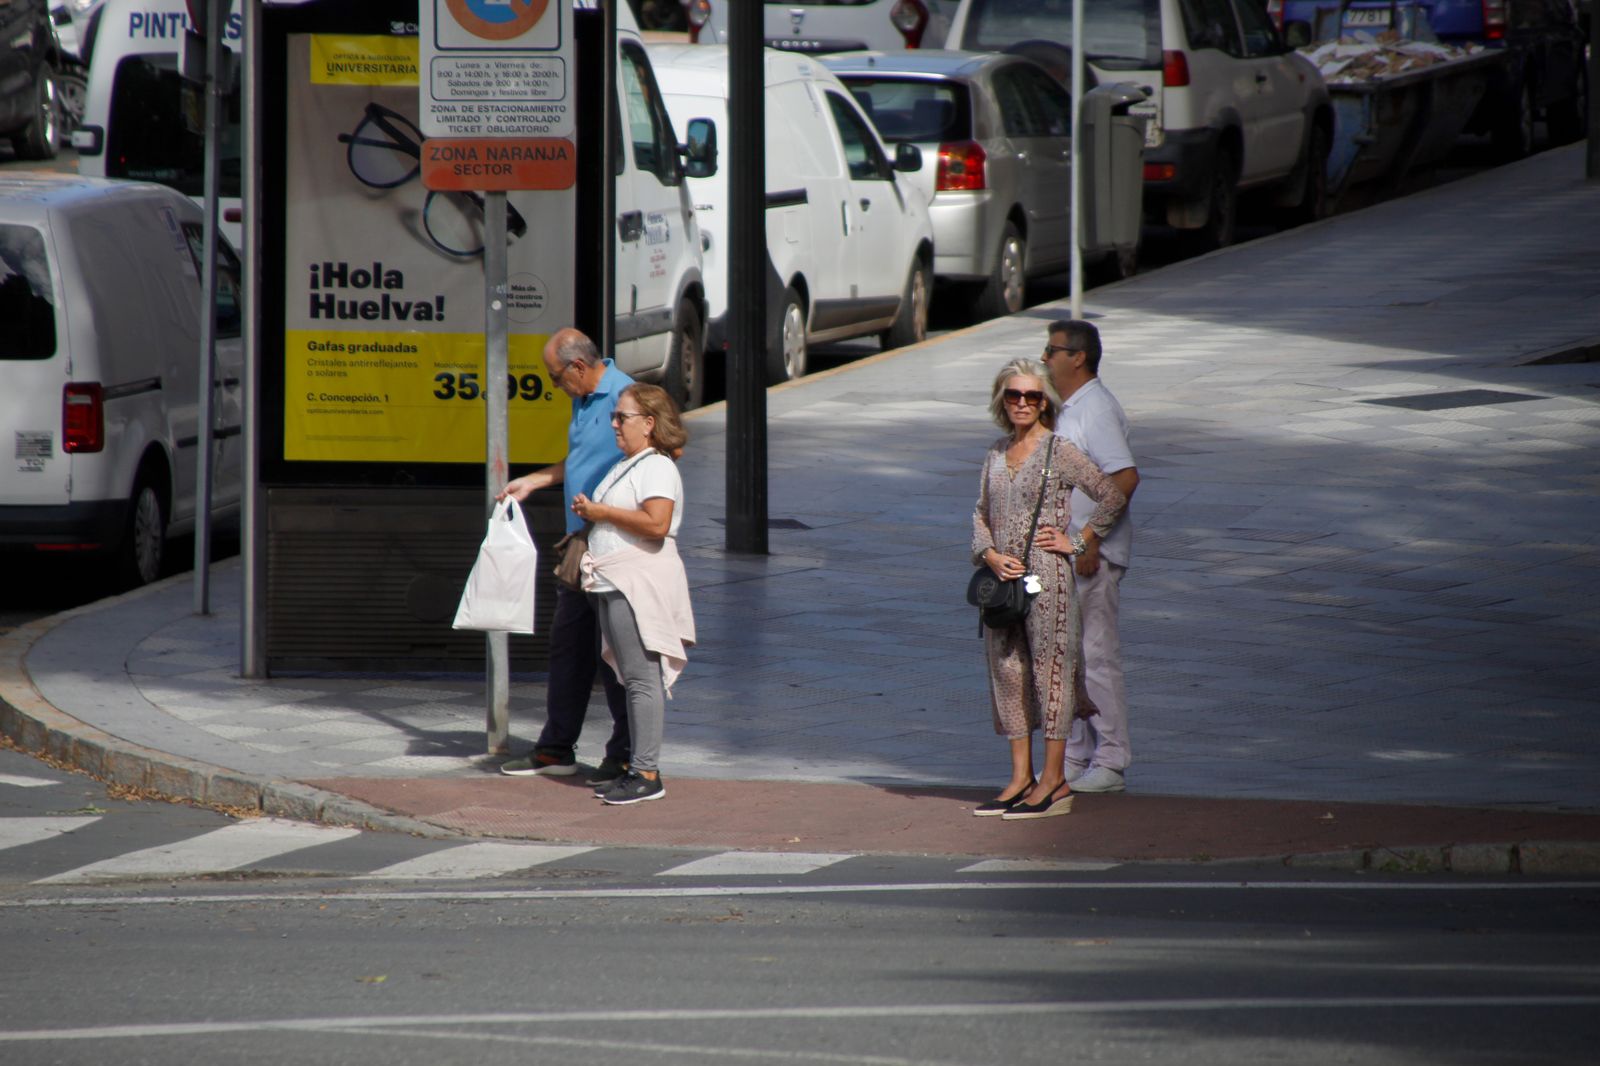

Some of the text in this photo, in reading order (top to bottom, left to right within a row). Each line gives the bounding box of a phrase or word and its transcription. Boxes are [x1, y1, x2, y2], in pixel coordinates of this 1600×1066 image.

[326, 62, 417, 74] UNIVERSITARIA
[455, 61, 480, 69] Lunes
[494, 61, 526, 69] Viernes
[483, 79, 493, 87] de
[450, 88, 489, 97] Domingos
[499, 88, 528, 96] festivos
[531, 88, 547, 96] libre
[430, 105, 566, 113] ZONA DE ESTACIONAMIENTO
[436, 115, 561, 123] LIMITADO Y CONTROLADO
[448, 125, 550, 133] TICKET OBLIGATORIO
[430, 147, 568, 161] ZONA NARANJA
[453, 164, 513, 175] SECTOR
[309, 261, 404, 290] ¡Hola
[309, 292, 445, 321] Huelva!
[306, 340, 418, 354] Gafas graduadas
[306, 358, 418, 369] Cristales antirreflejantes
[315, 369, 348, 377] solares
[306, 392, 317, 401] C.
[383, 394, 389, 402] 1
